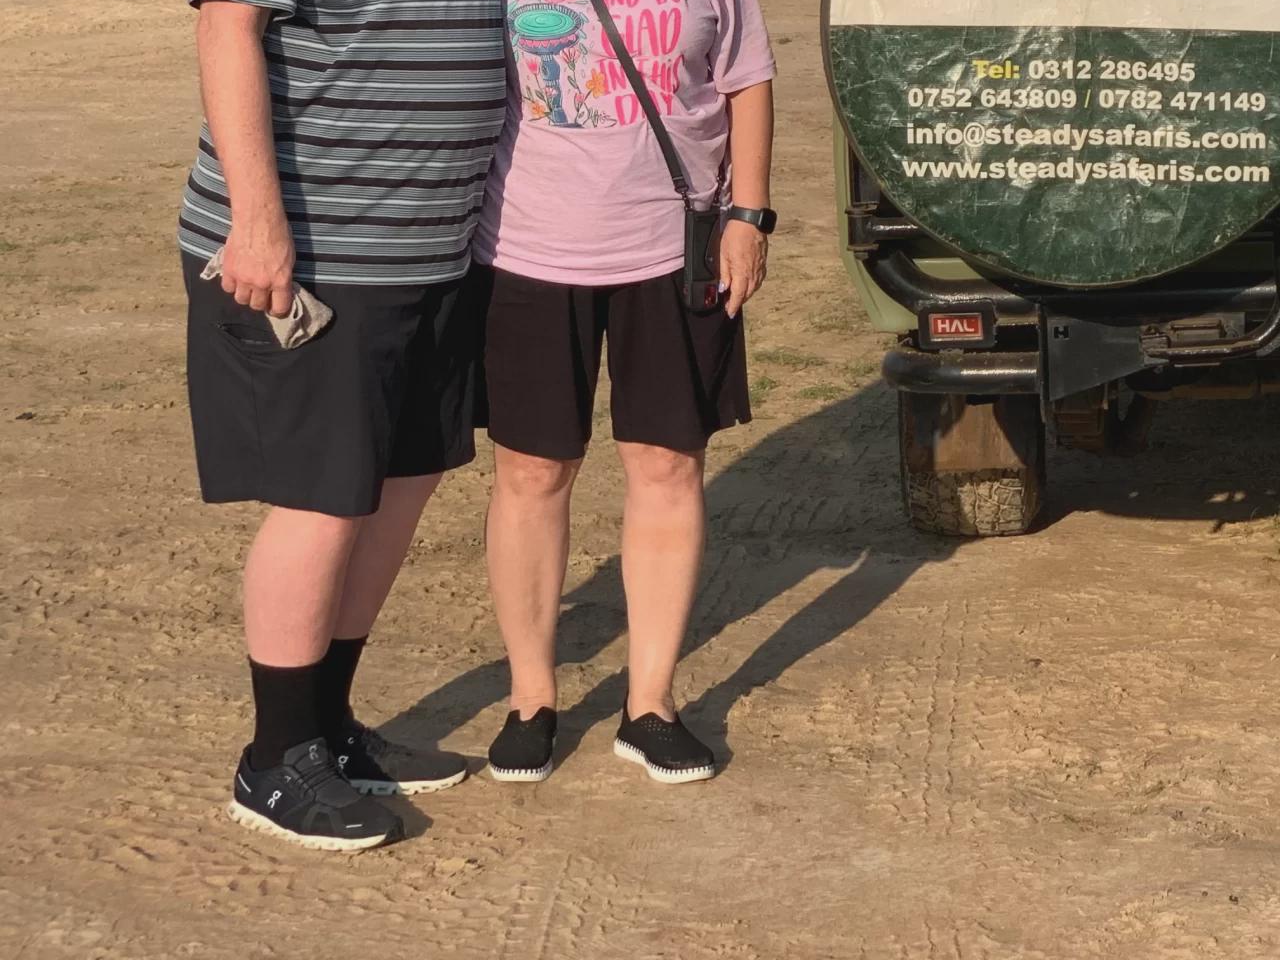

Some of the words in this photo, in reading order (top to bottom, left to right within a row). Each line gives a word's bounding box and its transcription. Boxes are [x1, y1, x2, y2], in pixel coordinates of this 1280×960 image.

[972, 59, 1021, 80] Tel:
[1028, 59, 1092, 80] 0312
[1099, 60, 1196, 82] 286495
[615, 91, 675, 127] DY
[907, 87, 972, 108] 0752
[980, 88, 1078, 108] 643809
[1083, 89, 1092, 109] /
[1099, 88, 1163, 110] 0782
[1170, 91, 1267, 111] 471149
[906, 121, 1267, 151] info@steadysafaris.com
[902, 156, 1271, 185] www.steadysafaris.com
[937, 318, 976, 333] HAL
